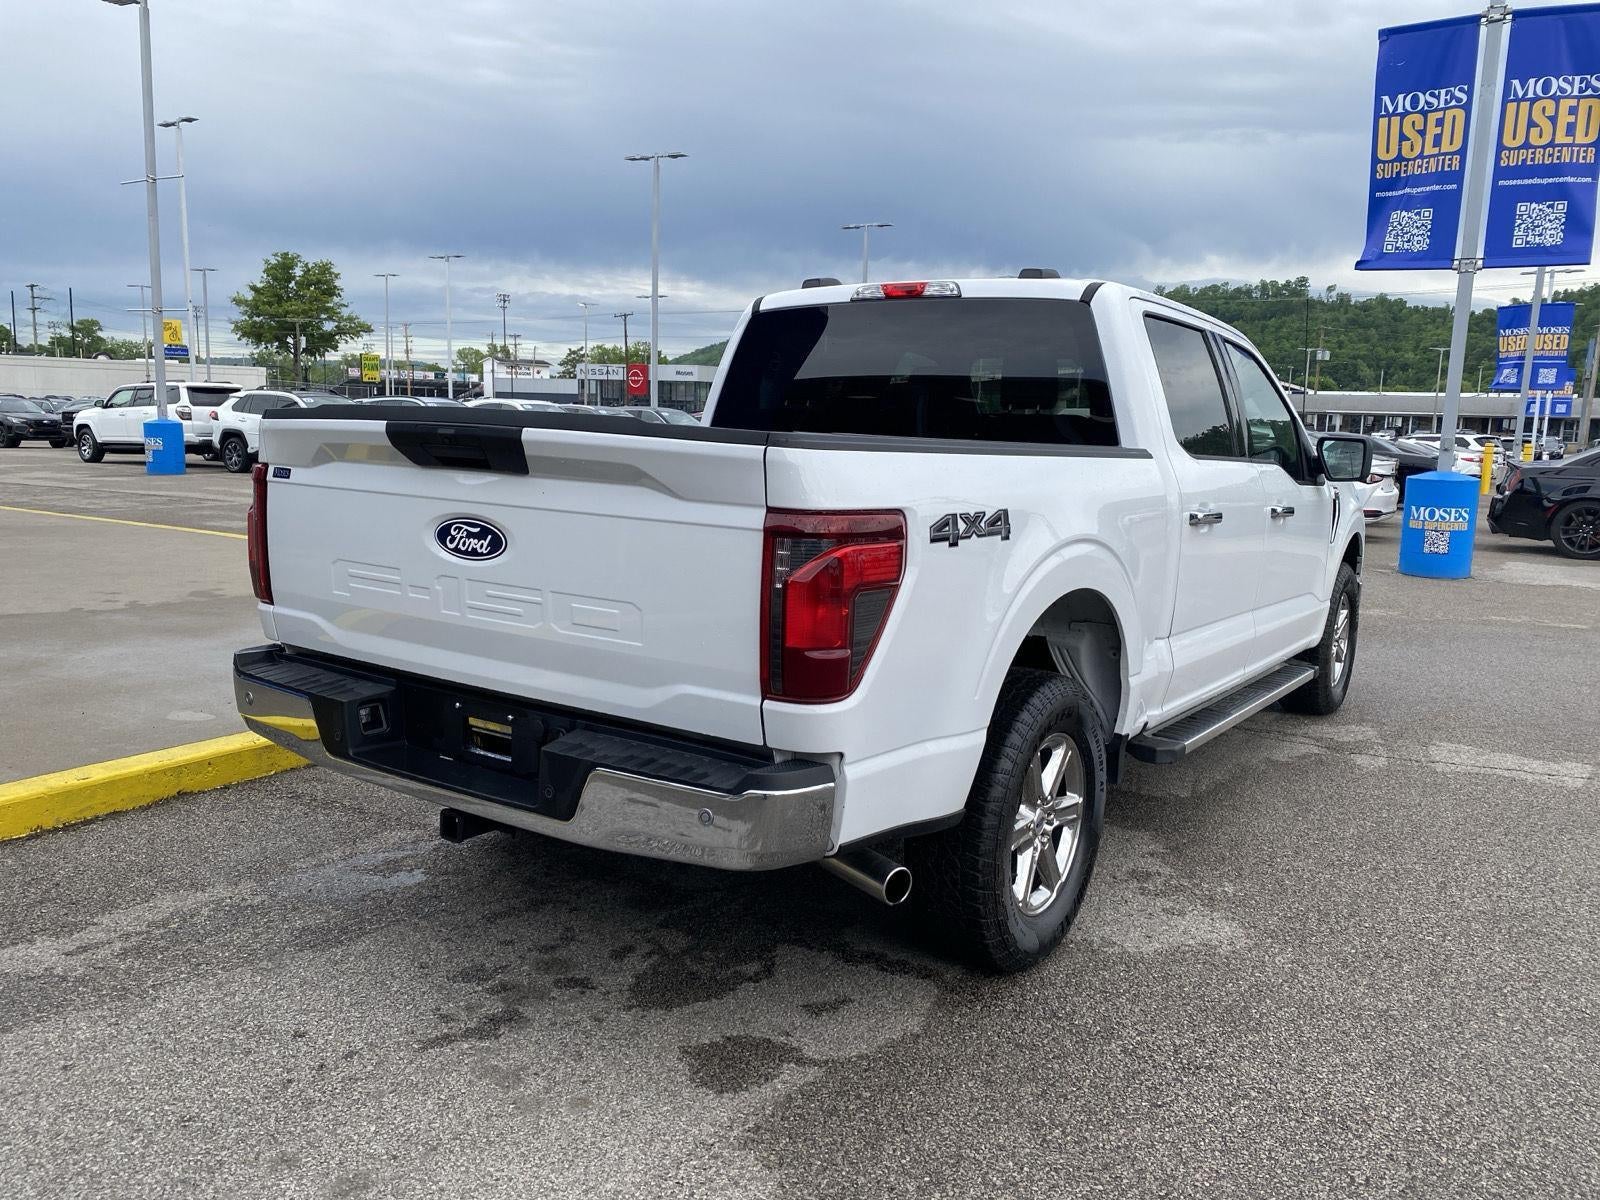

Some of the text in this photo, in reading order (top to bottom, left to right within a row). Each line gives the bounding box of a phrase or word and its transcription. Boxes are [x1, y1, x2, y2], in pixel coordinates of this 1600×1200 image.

[1508, 73, 1600, 100] MOSES
[1379, 84, 1469, 115] MOSES
[1502, 98, 1600, 148] USED
[1376, 107, 1466, 161] USED
[1500, 146, 1596, 167] SUPERCENTER
[1375, 154, 1461, 180] SUPERCENTER
[1498, 175, 1593, 187] mosesusedsupercenter.com
[1500, 327, 1530, 336] MOSES
[1537, 326, 1570, 334] MOSES
[1534, 333, 1569, 350] USED
[363, 362, 379, 371] PAWN
[579, 368, 619, 376] NISSAN
[144, 437, 163, 446] SES
[1410, 506, 1469, 522] MOSES
[446, 523, 492, 554] Ford
[332, 558, 644, 646] F-150
